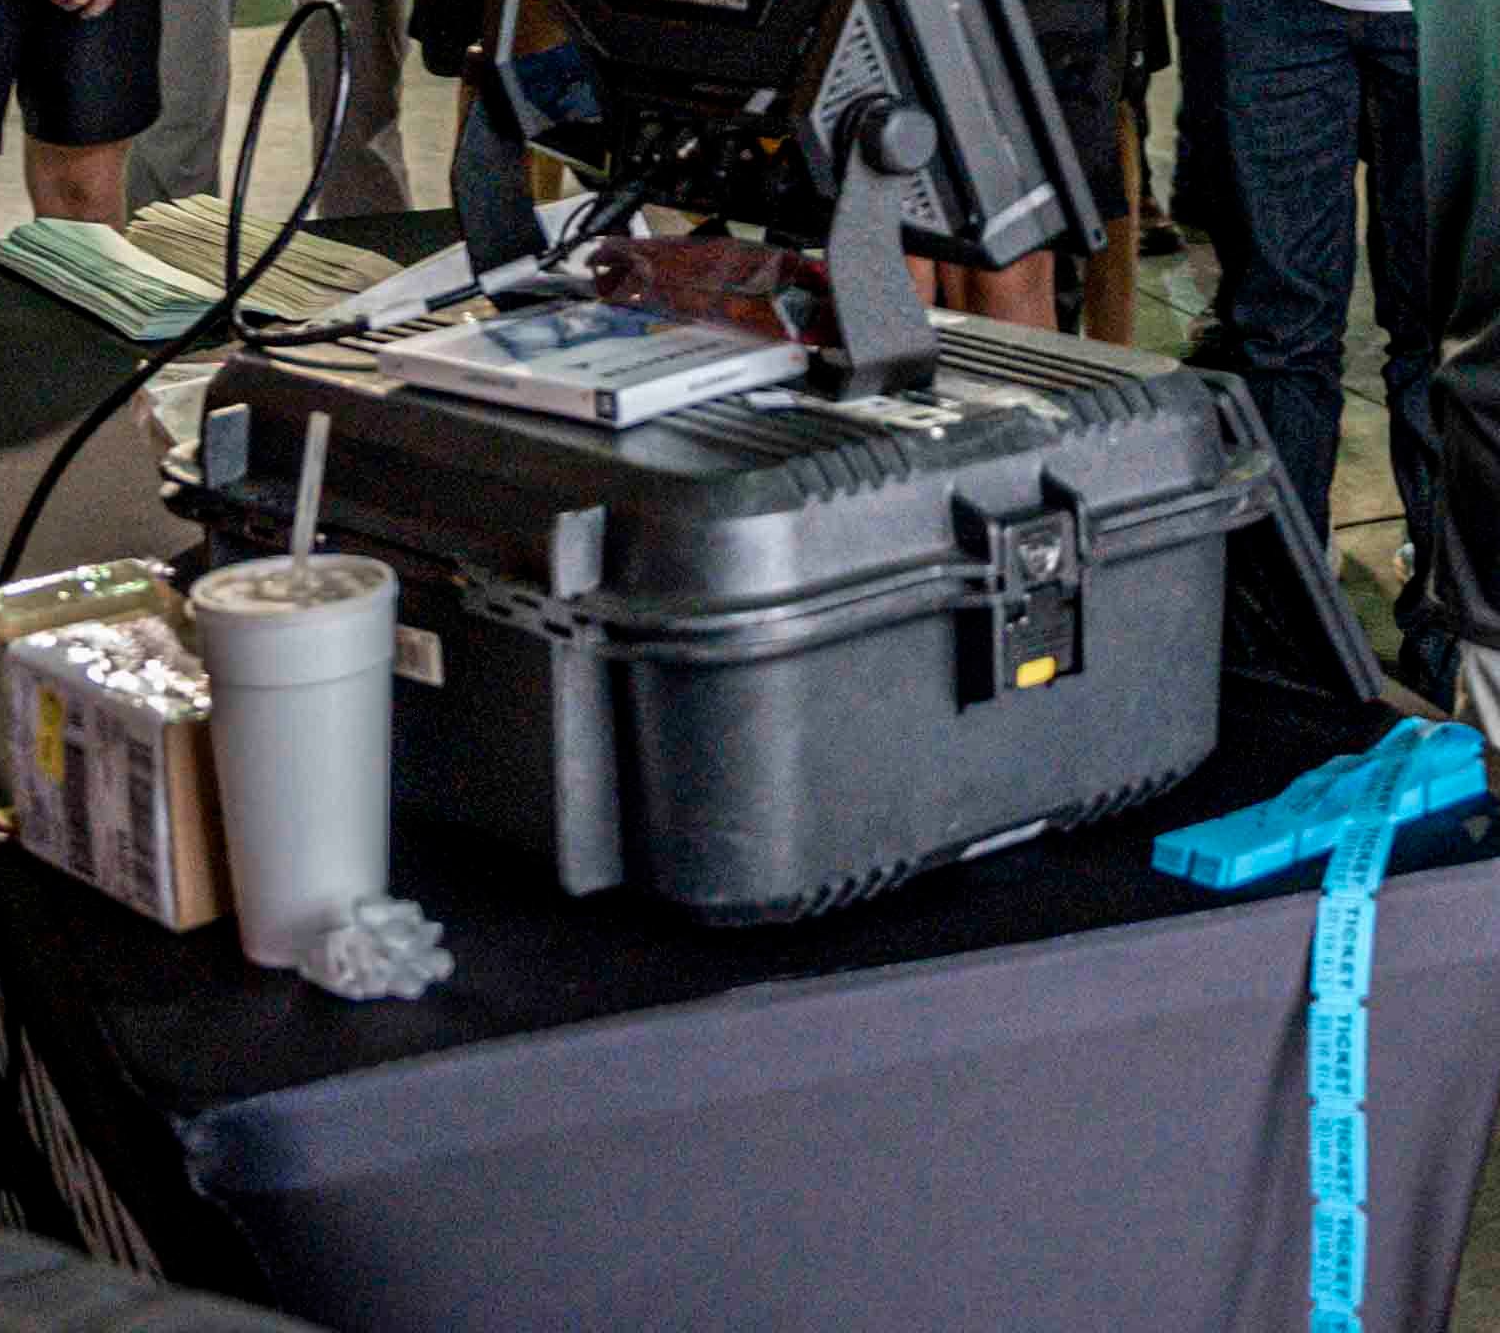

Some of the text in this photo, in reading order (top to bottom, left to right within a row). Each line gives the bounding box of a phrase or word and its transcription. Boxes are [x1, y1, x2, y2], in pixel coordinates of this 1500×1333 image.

[1339, 906, 1362, 991] TICKET
[1334, 1013, 1353, 1096] TICKET
[1334, 1116, 1353, 1196] TICKET
